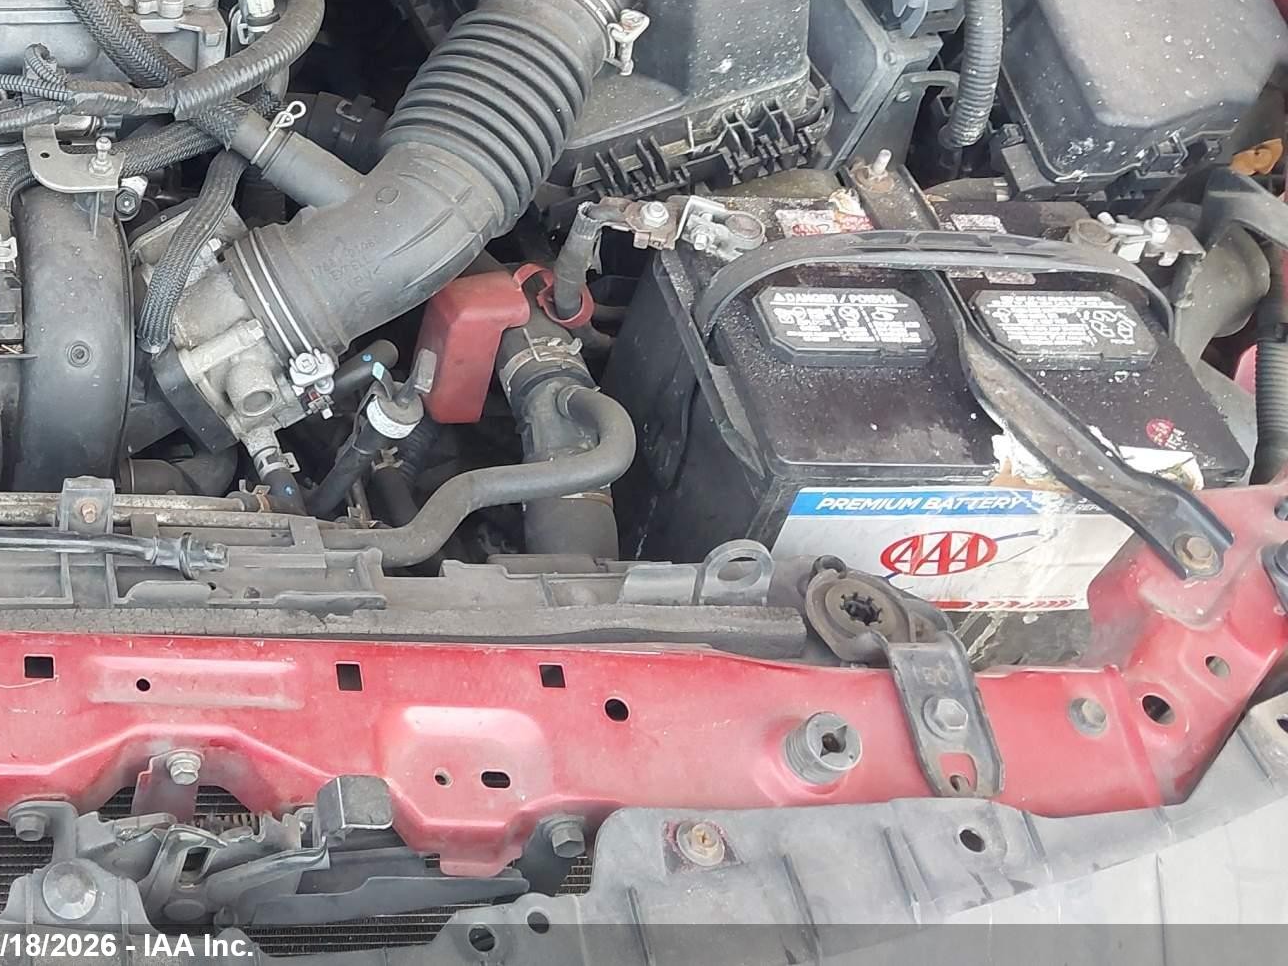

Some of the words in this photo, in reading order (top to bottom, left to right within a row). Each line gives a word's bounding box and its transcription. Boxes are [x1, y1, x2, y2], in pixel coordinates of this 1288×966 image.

[816, 497, 922, 511] PREMIUM
[921, 494, 1021, 512] BATTERY
[884, 531, 994, 576] AAA
